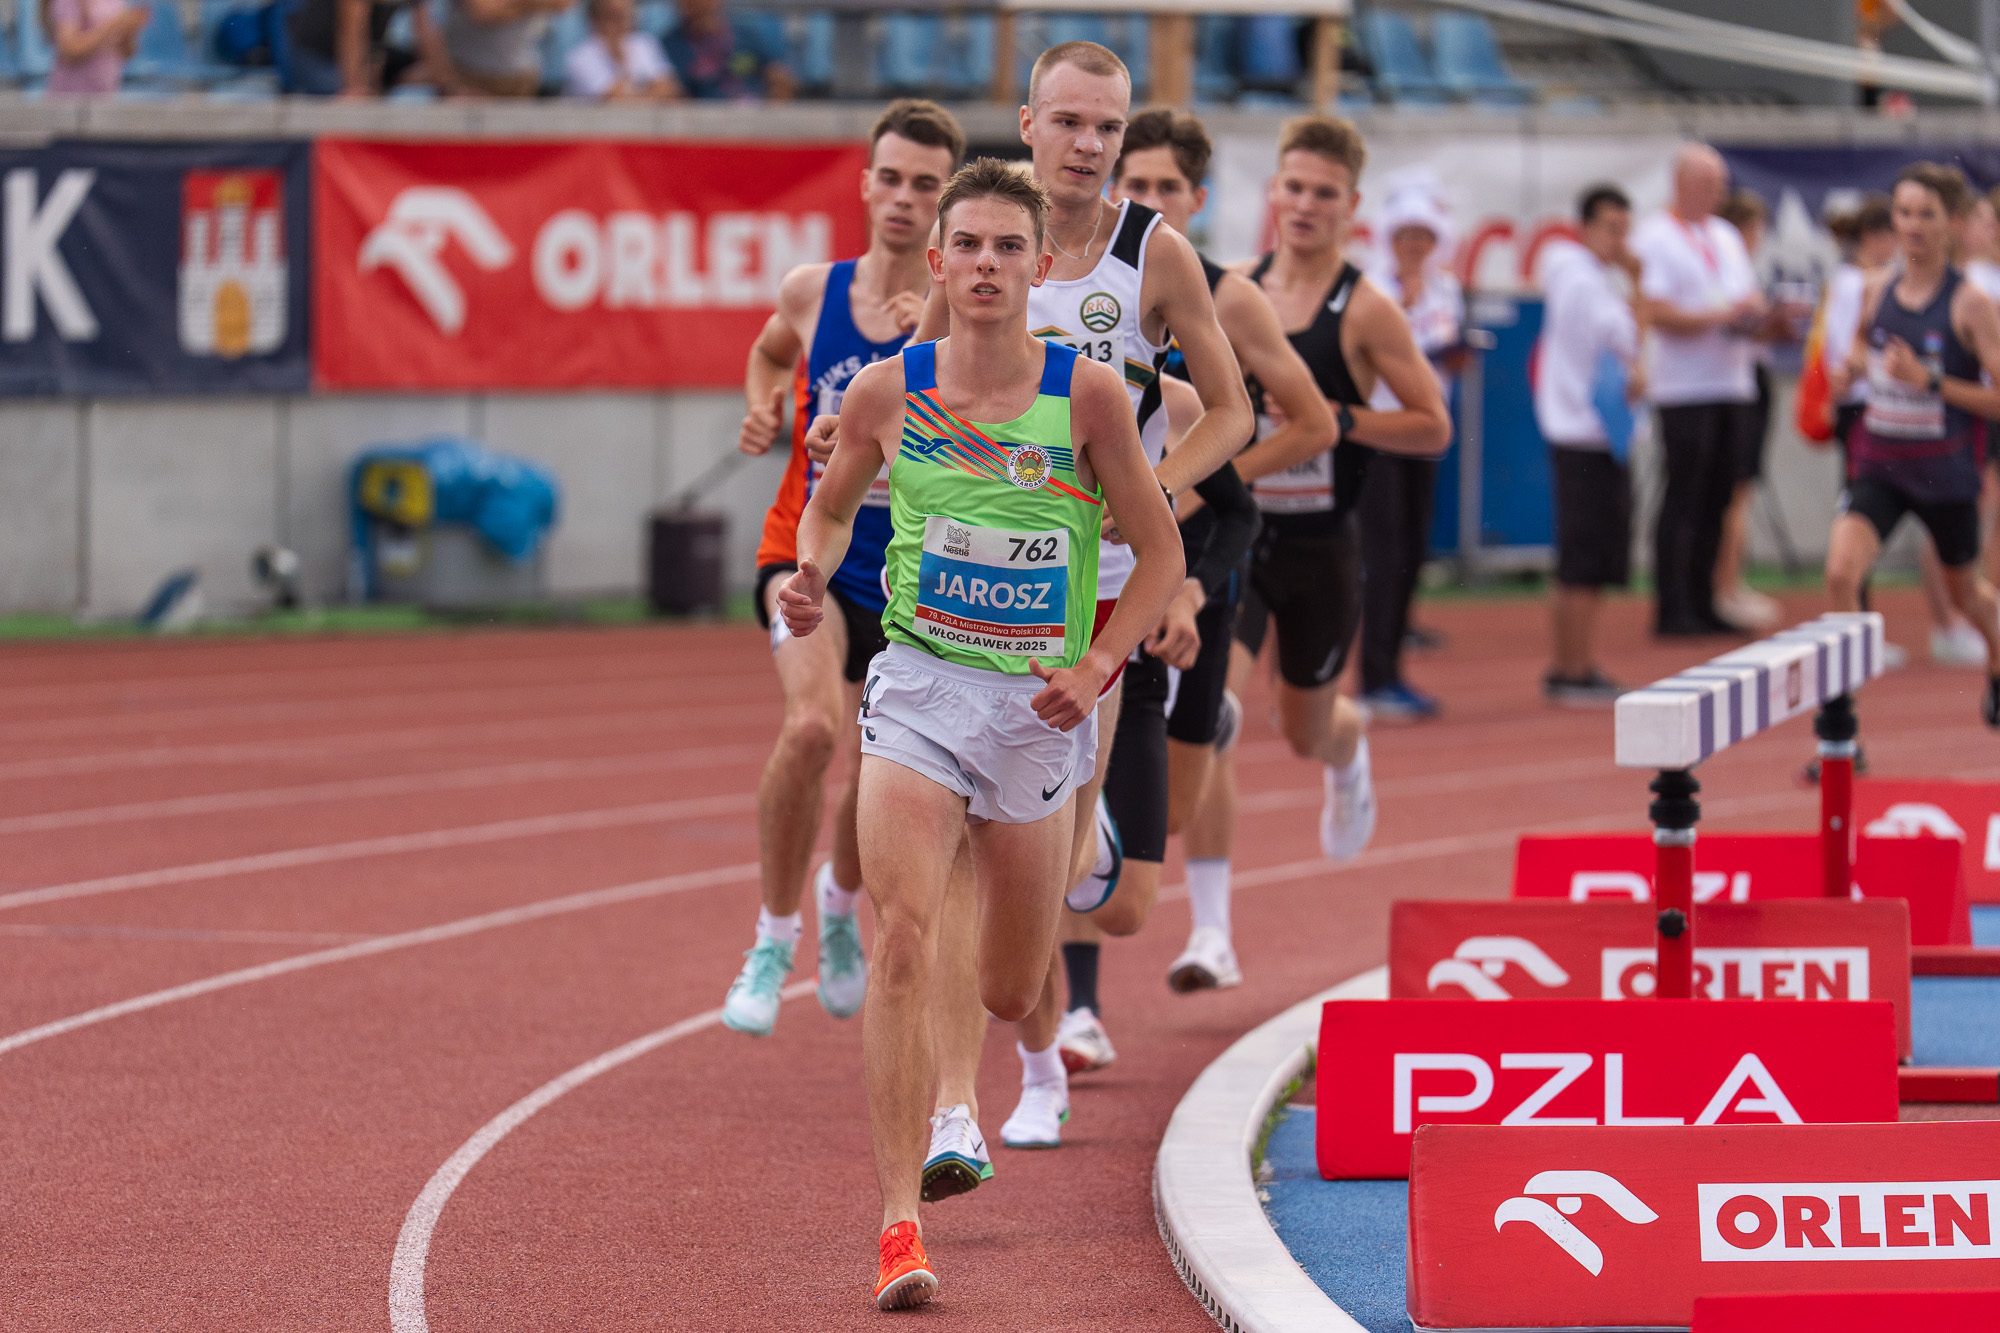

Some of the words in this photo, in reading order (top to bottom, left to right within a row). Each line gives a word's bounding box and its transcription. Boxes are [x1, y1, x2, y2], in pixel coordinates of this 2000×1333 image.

[533, 210, 832, 309] ORLEN
[1086, 299, 1115, 314] RKS
[1065, 341, 1112, 363] 13
[1020, 452, 1040, 460] LZS
[1028, 445, 1051, 468] POMORZE
[1012, 475, 1046, 488] STARGARD
[1008, 537, 1058, 562] 762
[934, 571, 1052, 610] JAROSZ
[928, 610, 940, 621] 79.
[940, 615, 958, 627] PZLA
[959, 620, 1009, 635] Mistrzostwa
[1010, 628, 1034, 636] Polski
[1035, 626, 1051, 635] U20
[928, 625, 1012, 651] WŁOCŁAWEK
[1015, 641, 1048, 651] 2025
[1393, 1052, 1804, 1134] PZLA
[1716, 1193, 1991, 1250] ORLEN
